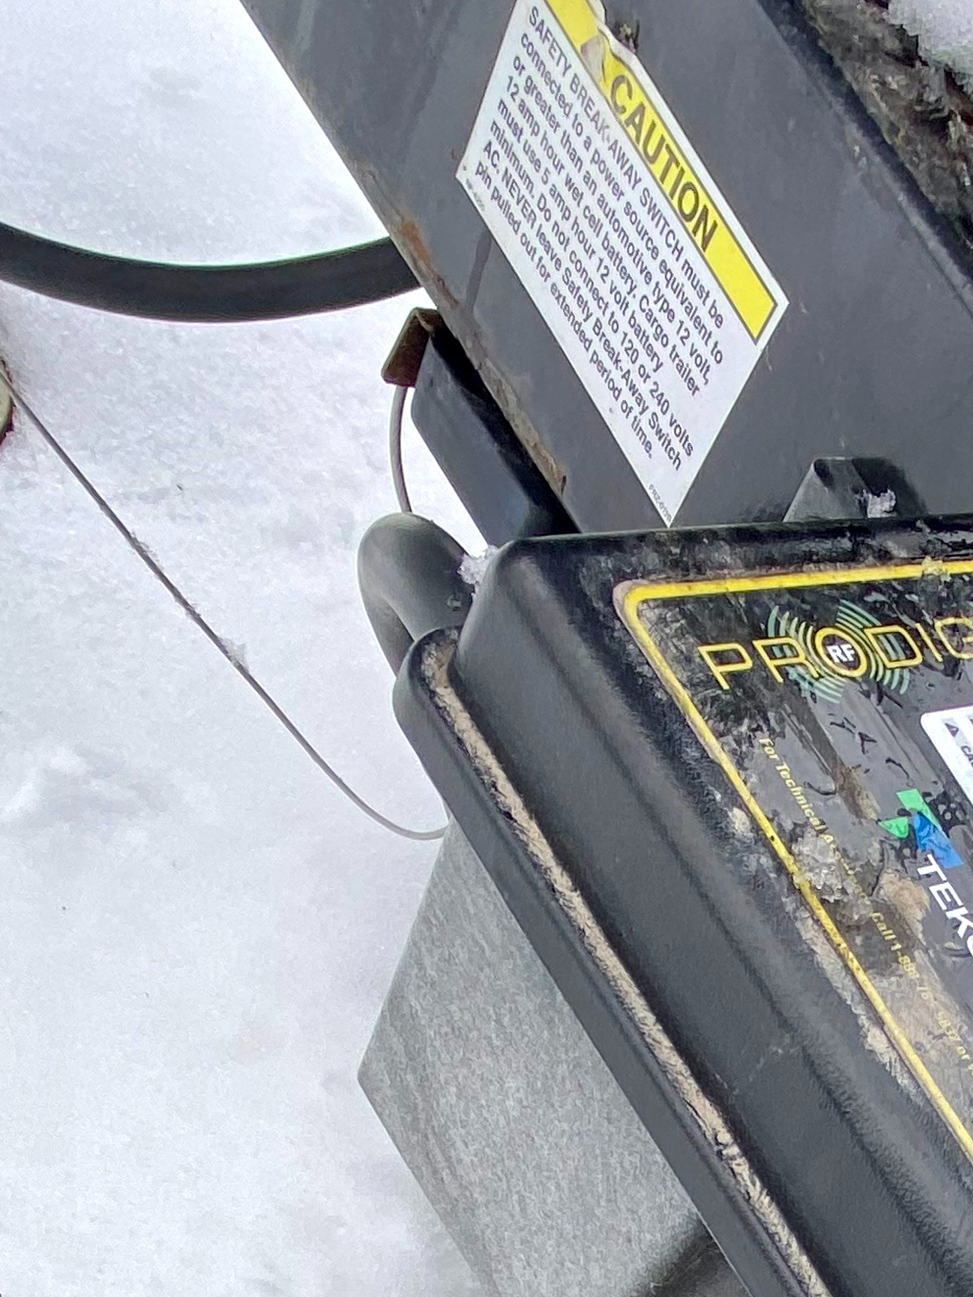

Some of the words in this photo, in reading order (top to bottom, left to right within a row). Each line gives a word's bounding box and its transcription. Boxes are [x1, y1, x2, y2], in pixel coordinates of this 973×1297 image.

[474, 160, 491, 189] pin
[490, 185, 521, 235] pulled
[520, 232, 537, 262] out
[535, 255, 551, 282] for
[550, 282, 593, 352] extended
[588, 349, 622, 401] period
[620, 399, 633, 419] of
[630, 414, 652, 459] time.
[482, 139, 499, 174] AC.
[501, 166, 536, 229] NEVER
[535, 223, 561, 271] leave
[561, 266, 593, 322] Safety
[592, 317, 649, 415] Break-Away
[648, 411, 681, 471] Switch
[490, 119, 534, 199] minimum.
[536, 192, 551, 222] Do
[551, 220, 570, 252] not
[568, 249, 609, 316] connect
[607, 310, 619, 333] to
[620, 330, 639, 364] 120
[637, 363, 651, 383] or
[649, 380, 669, 415] 240
[669, 412, 693, 456] volts
[497, 98, 523, 143] must
[522, 138, 541, 173] use
[540, 166, 550, 185] 5
[548, 183, 571, 221] amp
[570, 215, 596, 259] hour
[596, 256, 609, 284] 12
[609, 279, 629, 316] volt
[627, 309, 663, 373] battery
[506, 75, 519, 102] 12
[517, 98, 540, 136] amp
[539, 129, 565, 175] hour
[564, 172, 584, 207] wet
[582, 205, 603, 238] cell
[601, 230, 637, 299] battery.
[638, 294, 669, 348] Cargo
[668, 343, 699, 396] trailer
[512, 55, 525, 76] or
[523, 74, 560, 133] greater
[560, 129, 583, 173] than
[582, 170, 597, 196] an
[596, 193, 652, 285] automotive
[652, 280, 675, 323] type
[676, 319, 690, 346] 12
[689, 342, 710, 385] volt,
[520, 32, 573, 118] connected
[571, 112, 583, 137] to
[583, 135, 591, 152] a
[589, 147, 624, 201] power
[623, 200, 659, 260] source
[658, 258, 712, 346] equivalent
[710, 340, 722, 364] to
[528, 5, 572, 77] SAFETY
[569, 72, 642, 190] BREAK-AWAY
[639, 187, 683, 262] SWITCH
[680, 258, 710, 306] must
[707, 298, 723, 328] be
[610, 74, 718, 252] CAUTION
[830, 641, 857, 664] RF
[756, 737, 783, 760] For
[773, 762, 828, 832] Technical
[867, 909, 897, 942] Call
[954, 1041, 973, 1064] or
